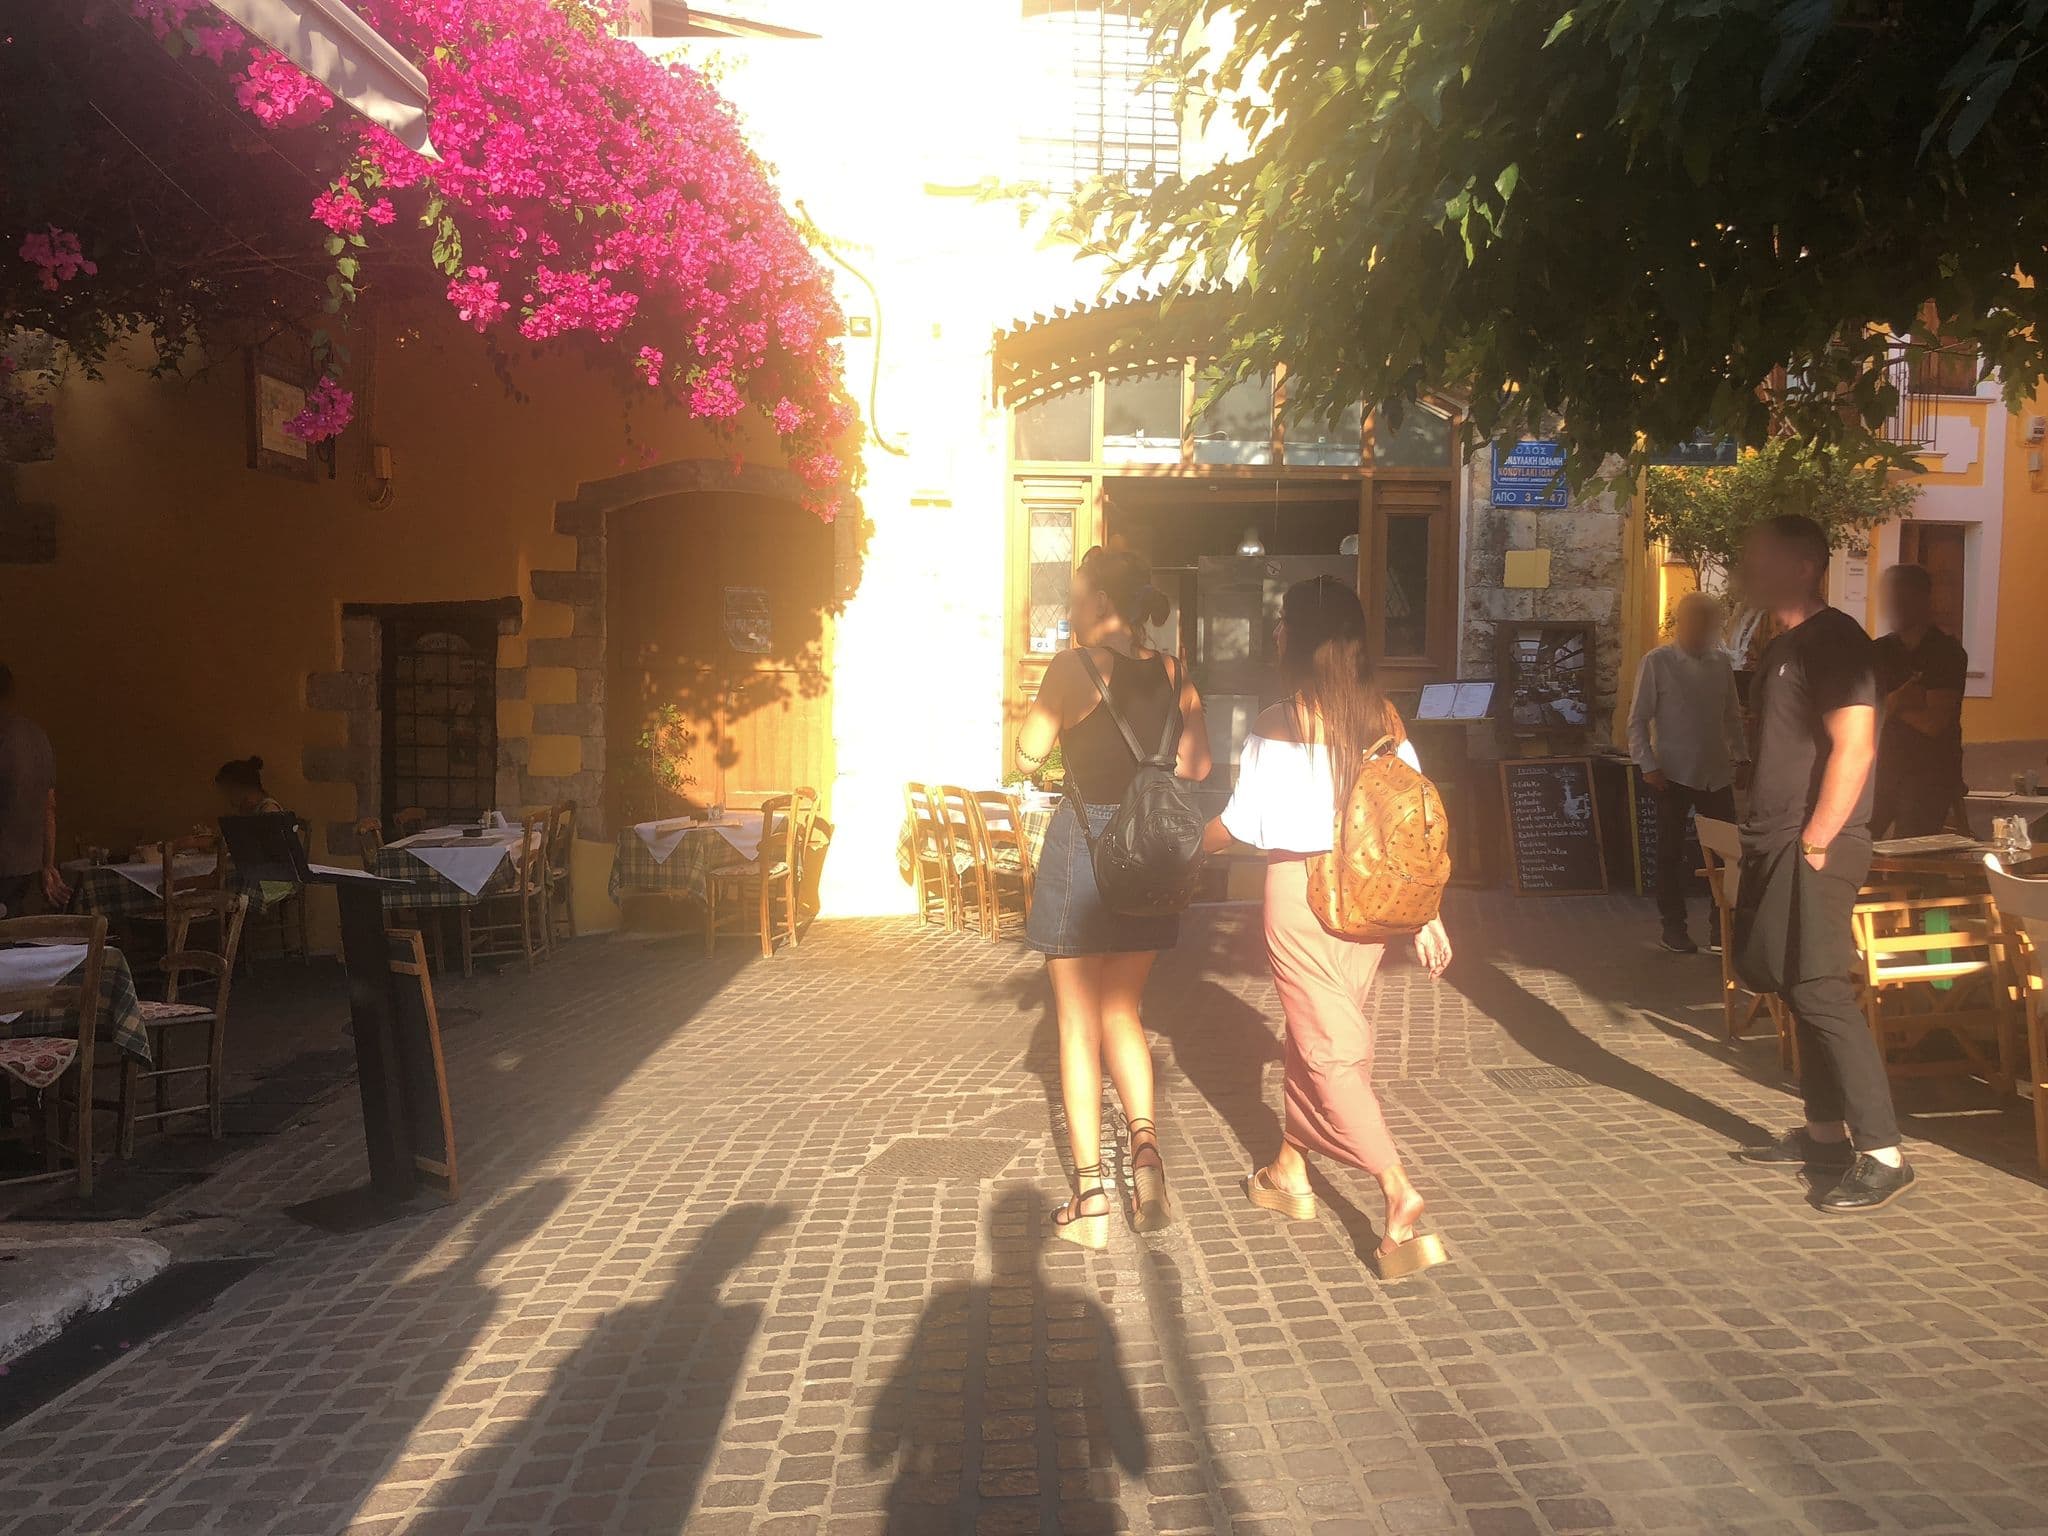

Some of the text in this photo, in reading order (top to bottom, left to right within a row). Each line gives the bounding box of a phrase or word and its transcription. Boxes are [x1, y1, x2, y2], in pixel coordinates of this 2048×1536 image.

[1515, 446, 1547, 455] ΟΔΟΣ
[1504, 455, 1538, 465] ΝΔΥΛΑΚΗ
[1498, 467, 1559, 477] KONDYLAKI IOAN
[1495, 492, 1516, 502] ΑΠΟ
[1524, 493, 1531, 502] 3
